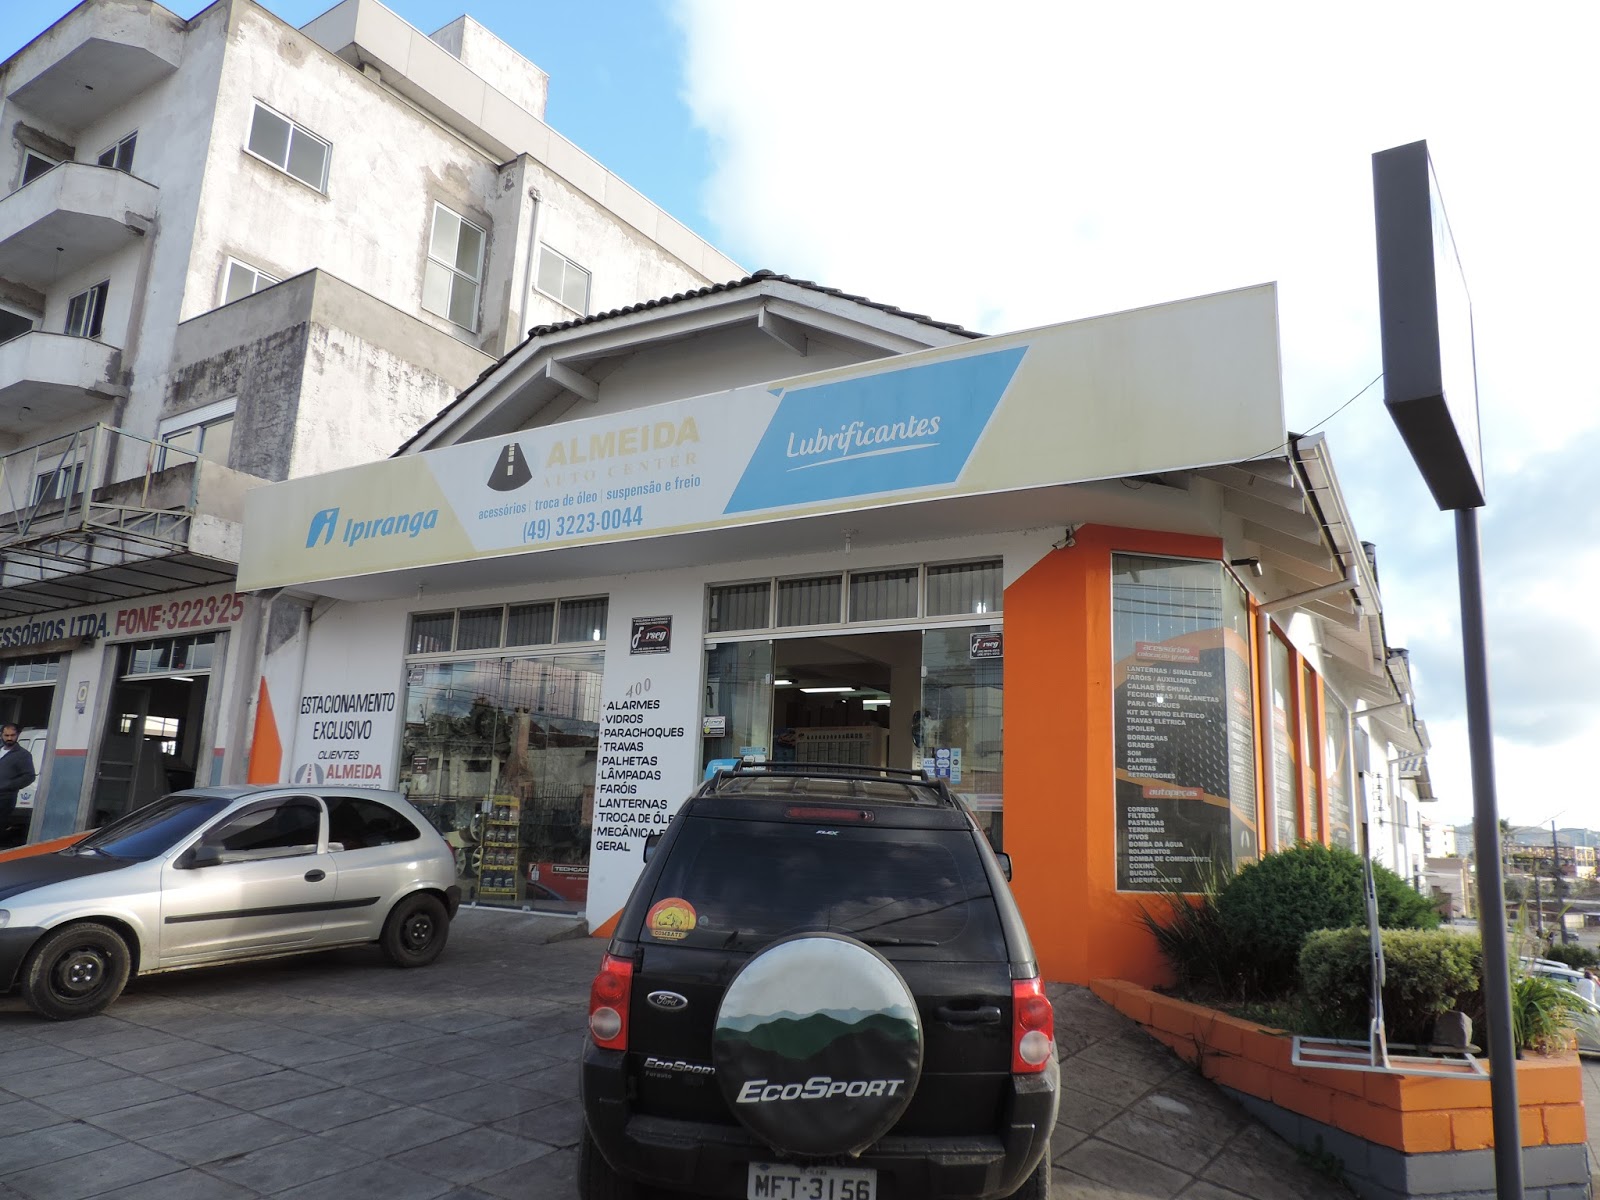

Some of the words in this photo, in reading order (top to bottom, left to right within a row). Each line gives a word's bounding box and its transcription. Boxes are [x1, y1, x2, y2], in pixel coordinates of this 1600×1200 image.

[546, 416, 700, 468] ALMEIDA
[786, 416, 940, 458] Lubrificantes
[608, 452, 696, 477] CENTER
[478, 503, 526, 520] acessórios
[535, 498, 559, 510] troca
[562, 494, 574, 506] de
[577, 491, 597, 504] óleo
[607, 480, 661, 500] suspensão
[665, 481, 671, 491] e
[675, 474, 700, 489] freio
[343, 510, 439, 547] Ipiranga
[523, 519, 550, 543] (49)
[69, 612, 110, 638] LTDA.
[1143, 644, 1190, 653] acessórios
[1172, 669, 1212, 677] SINALEIRAS
[626, 678, 651, 698] 400
[301, 692, 395, 714] ESTACIONAMENTO
[607, 700, 660, 710] ALARMES
[606, 714, 644, 724] VIDROS
[1173, 710, 1205, 718] ELÉTRICO
[313, 720, 372, 740] EXCLUSIVO
[604, 728, 684, 739] PARACHOQUES
[604, 742, 644, 751] TRAVAS
[318, 751, 360, 759] CLIENTES
[602, 756, 658, 766] PALHETAS
[326, 764, 382, 779] ALMEIDA
[601, 767, 661, 780] LÂMPADAS
[600, 781, 637, 794] FARÓIS
[599, 798, 667, 810] LANTERNAS
[599, 812, 636, 822] TROCA
[638, 814, 650, 823] DE
[653, 811, 674, 824] ÓLE
[597, 824, 655, 838] MECÂNICA
[596, 841, 630, 852] GERAL
[656, 995, 677, 1006] Ford
